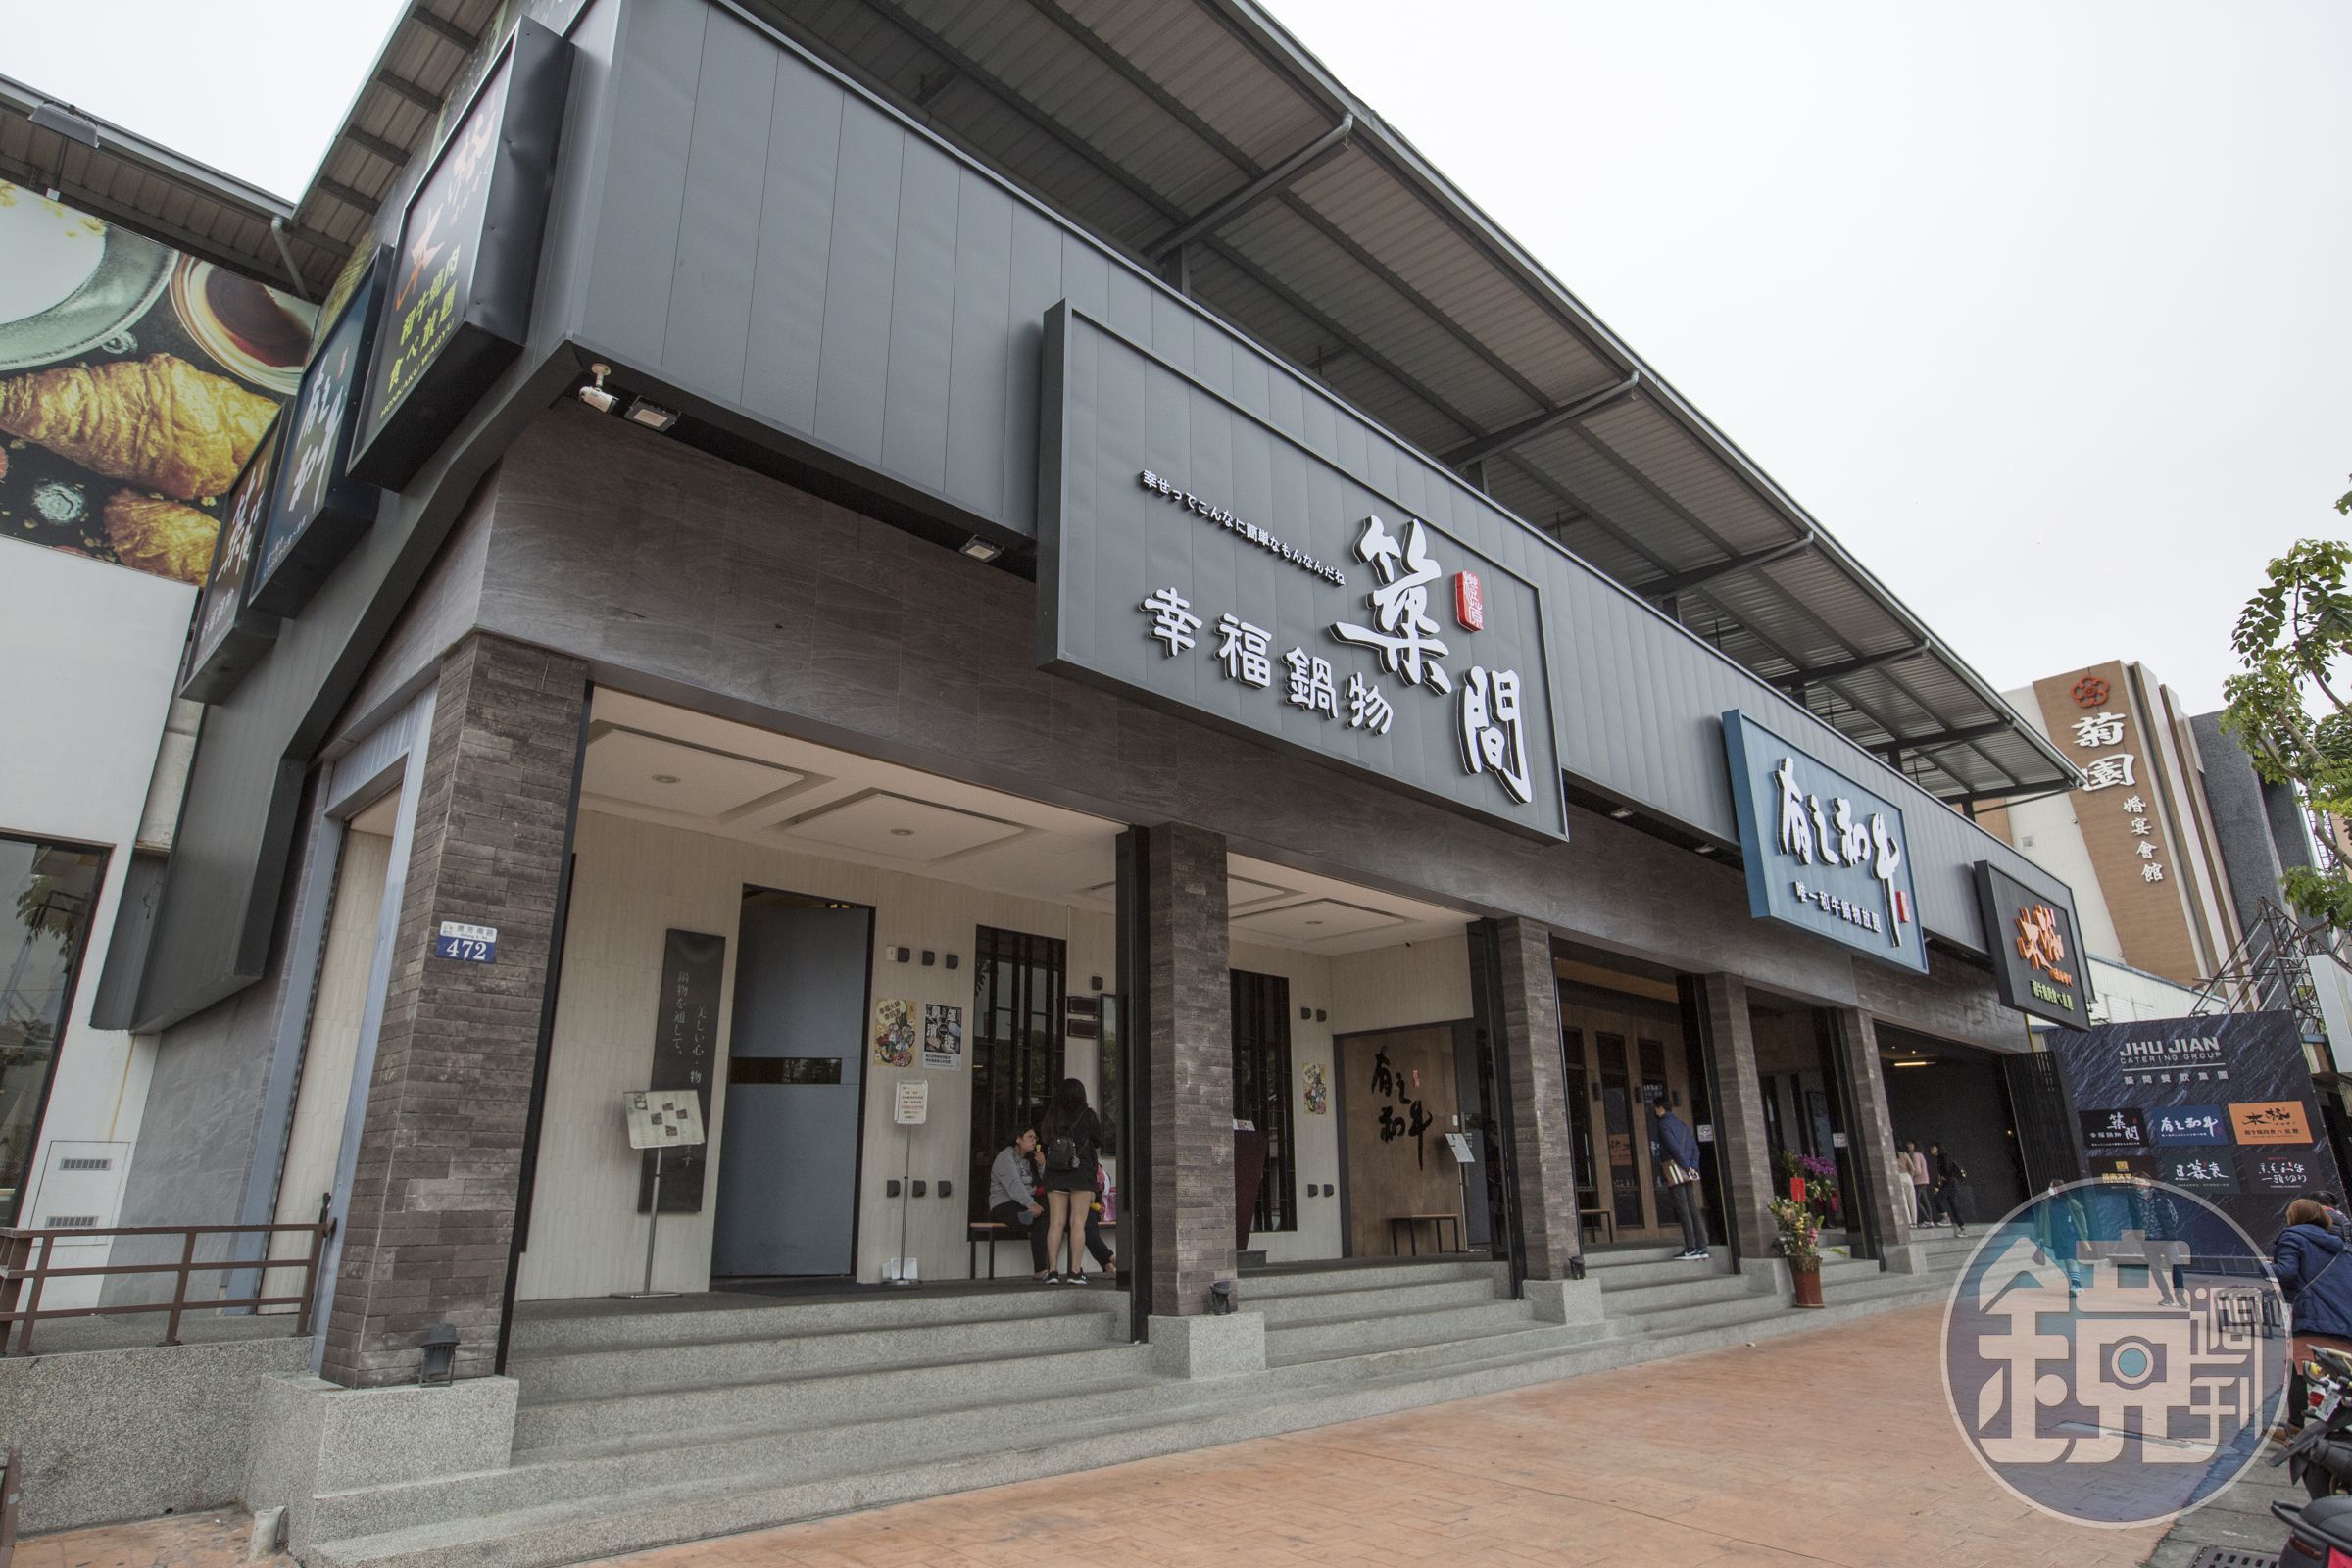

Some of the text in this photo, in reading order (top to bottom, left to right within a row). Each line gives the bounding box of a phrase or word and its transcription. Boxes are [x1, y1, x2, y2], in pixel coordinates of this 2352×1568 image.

[420, 316, 456, 368] WAGYU
[1141, 469, 1346, 586] 幸せってこんなに簡単なもんなんだね
[1140, 587, 1394, 735] 幸福鍋物
[2071, 712, 2136, 792] 菊園
[2124, 795, 2165, 882] 婚宴會館
[1793, 880, 1882, 933] 唯一和牛鍋物放題
[446, 938, 487, 960] 472
[2120, 1037, 2220, 1056] JHU JIAN
[2120, 1052, 2222, 1065] CATERING GROUP
